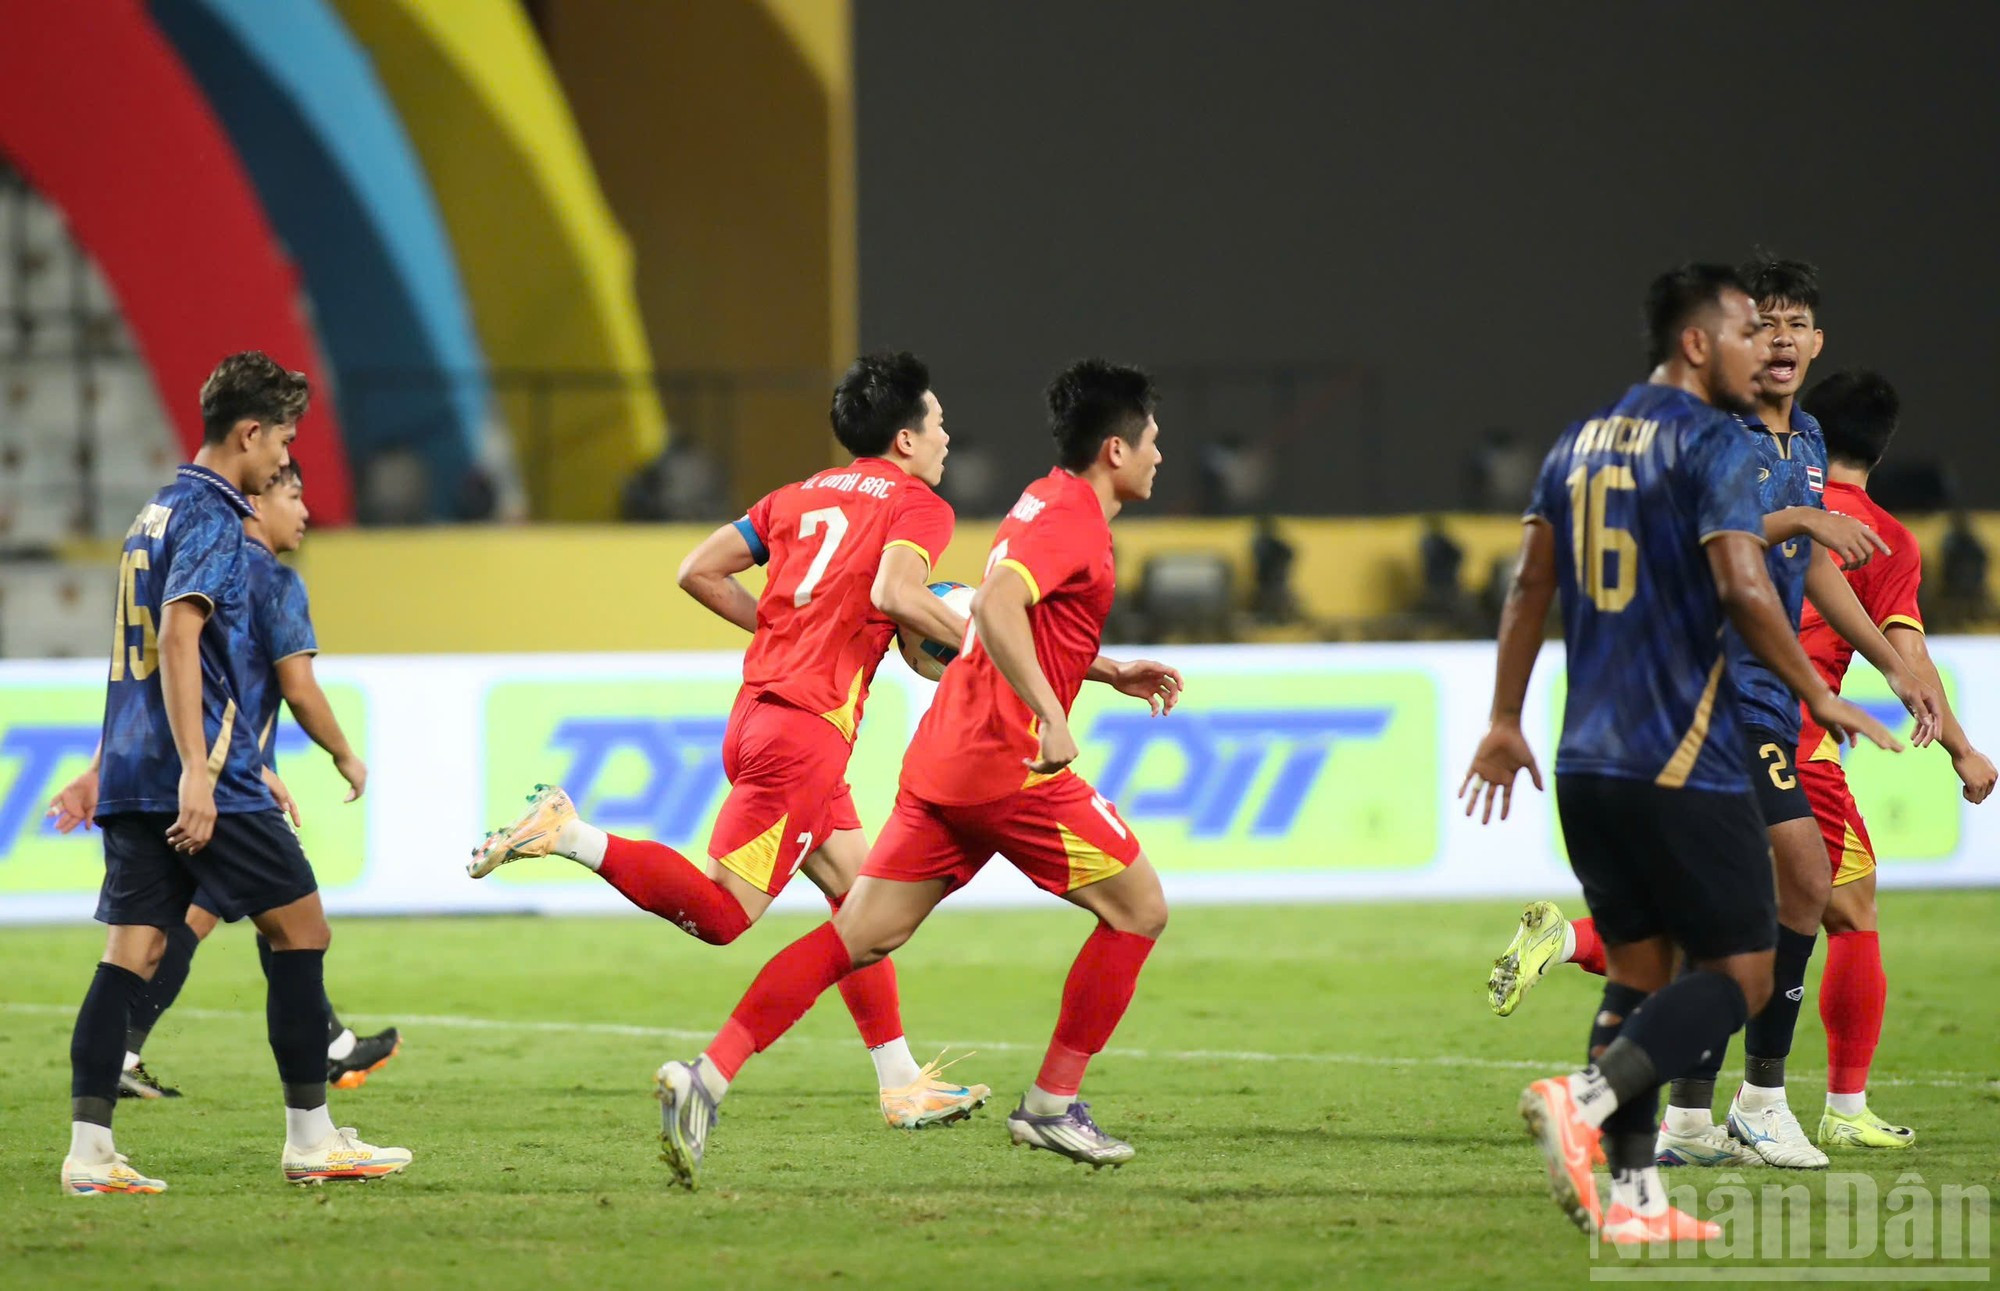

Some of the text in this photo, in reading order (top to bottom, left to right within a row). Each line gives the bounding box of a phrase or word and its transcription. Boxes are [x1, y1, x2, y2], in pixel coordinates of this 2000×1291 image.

[793, 506, 849, 608] 7
[1565, 465, 1638, 612] 16
[110, 549, 159, 681] 15
[1759, 743, 1797, 790] 2
[788, 831, 813, 875] 7
[326, 1151, 373, 1163] SUPER
